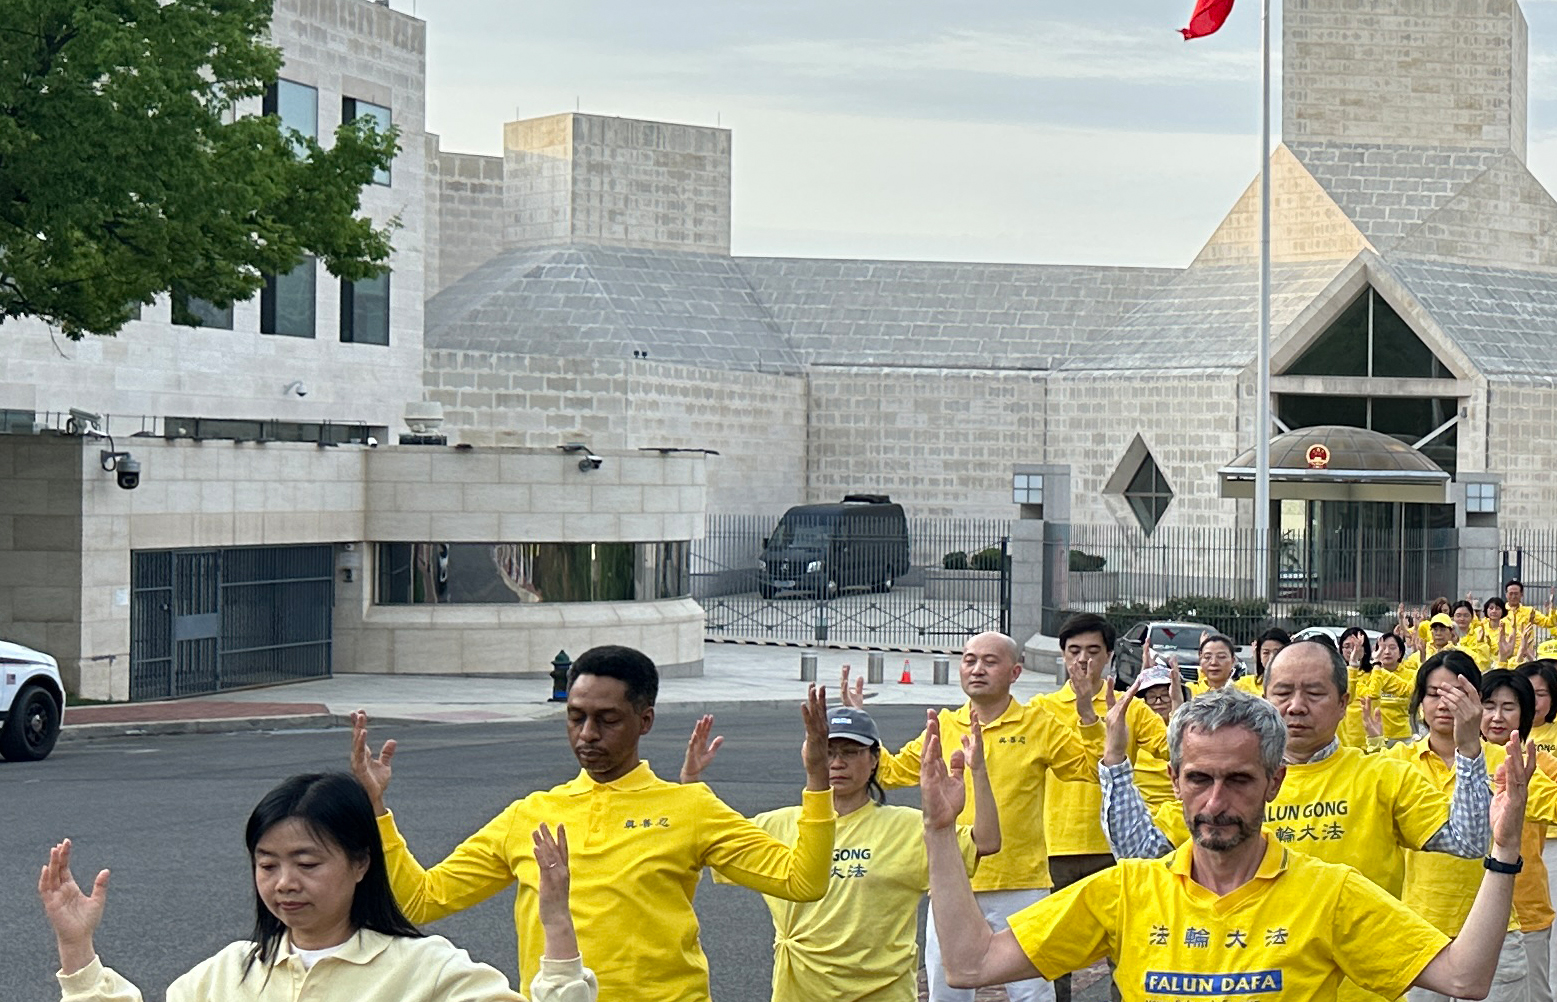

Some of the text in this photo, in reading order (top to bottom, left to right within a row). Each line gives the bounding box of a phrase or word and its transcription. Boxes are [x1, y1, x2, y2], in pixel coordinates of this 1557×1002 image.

[1262, 800, 1348, 822] LUN GONG
[832, 848, 871, 861] GONG
[1150, 924, 1289, 949] 法輪大法
[1149, 974, 1277, 992] FALUN DAFA
